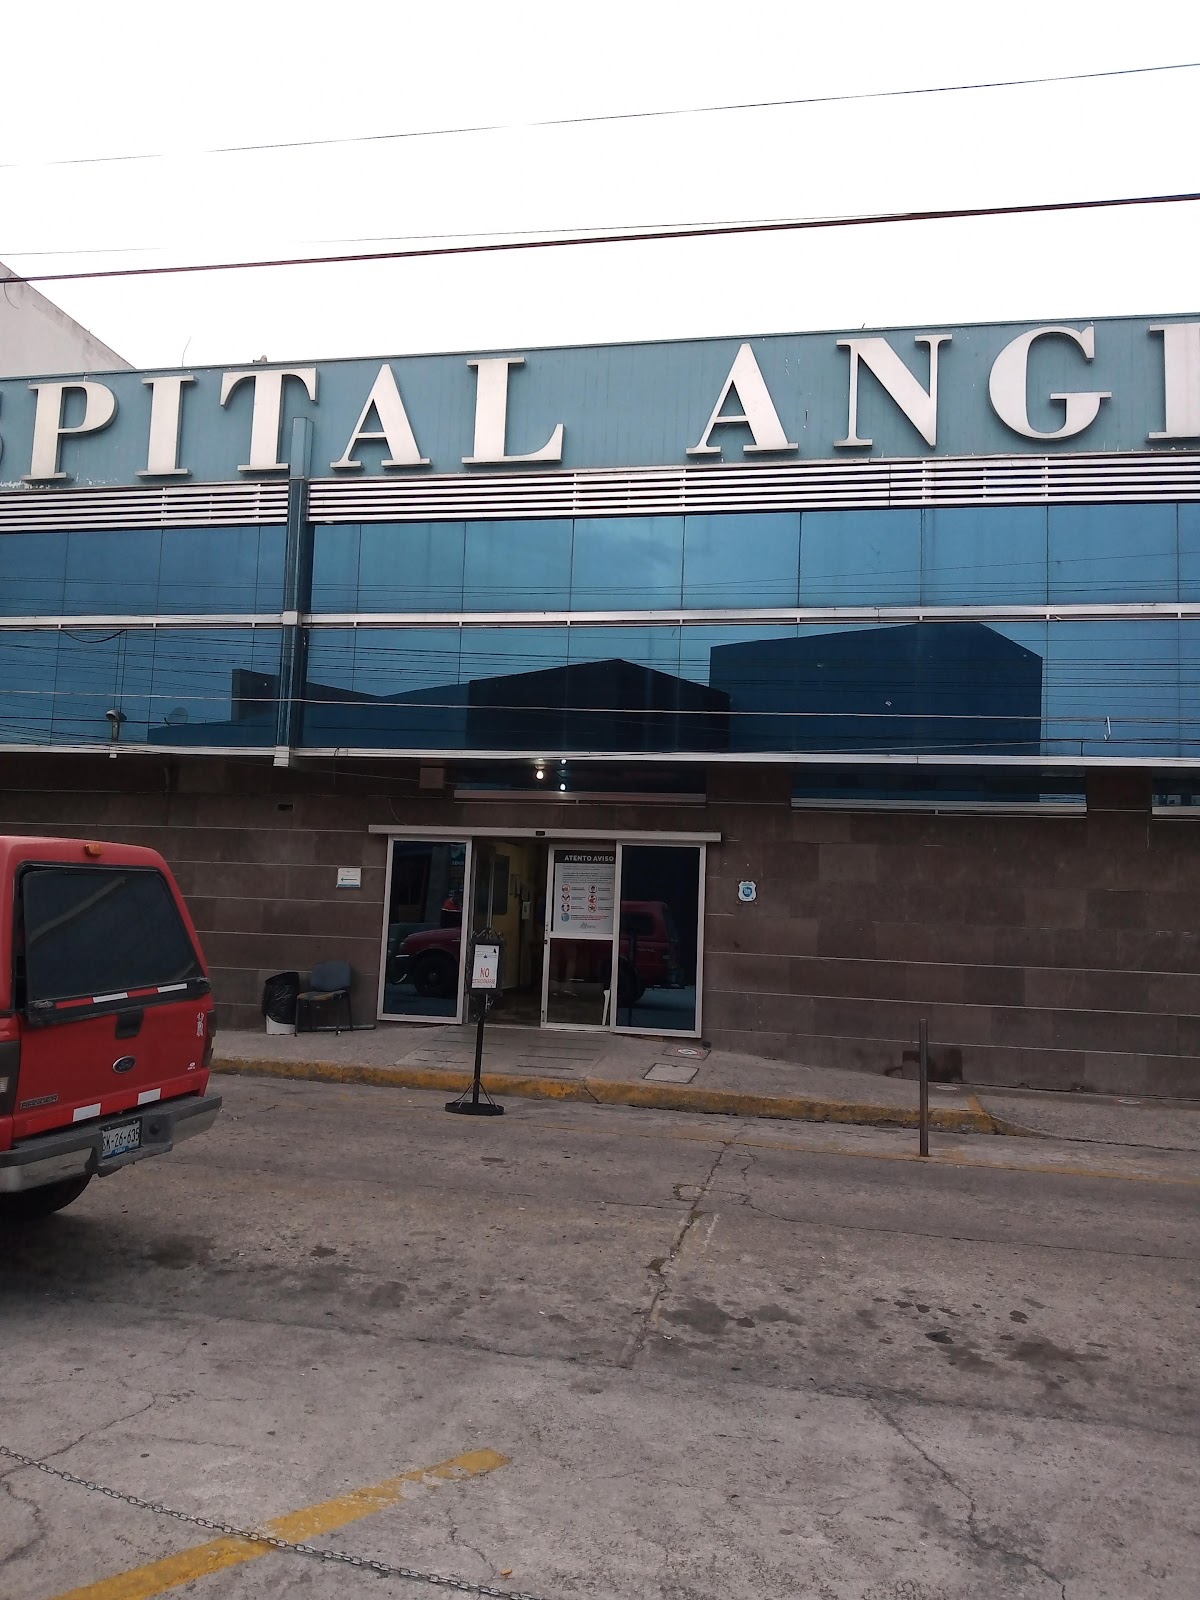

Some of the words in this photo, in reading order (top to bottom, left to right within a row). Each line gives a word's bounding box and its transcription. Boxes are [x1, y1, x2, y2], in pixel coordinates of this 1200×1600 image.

[0, 356, 565, 480] PITAL
[564, 854, 592, 862] ATENTO
[480, 967, 490, 978] NO
